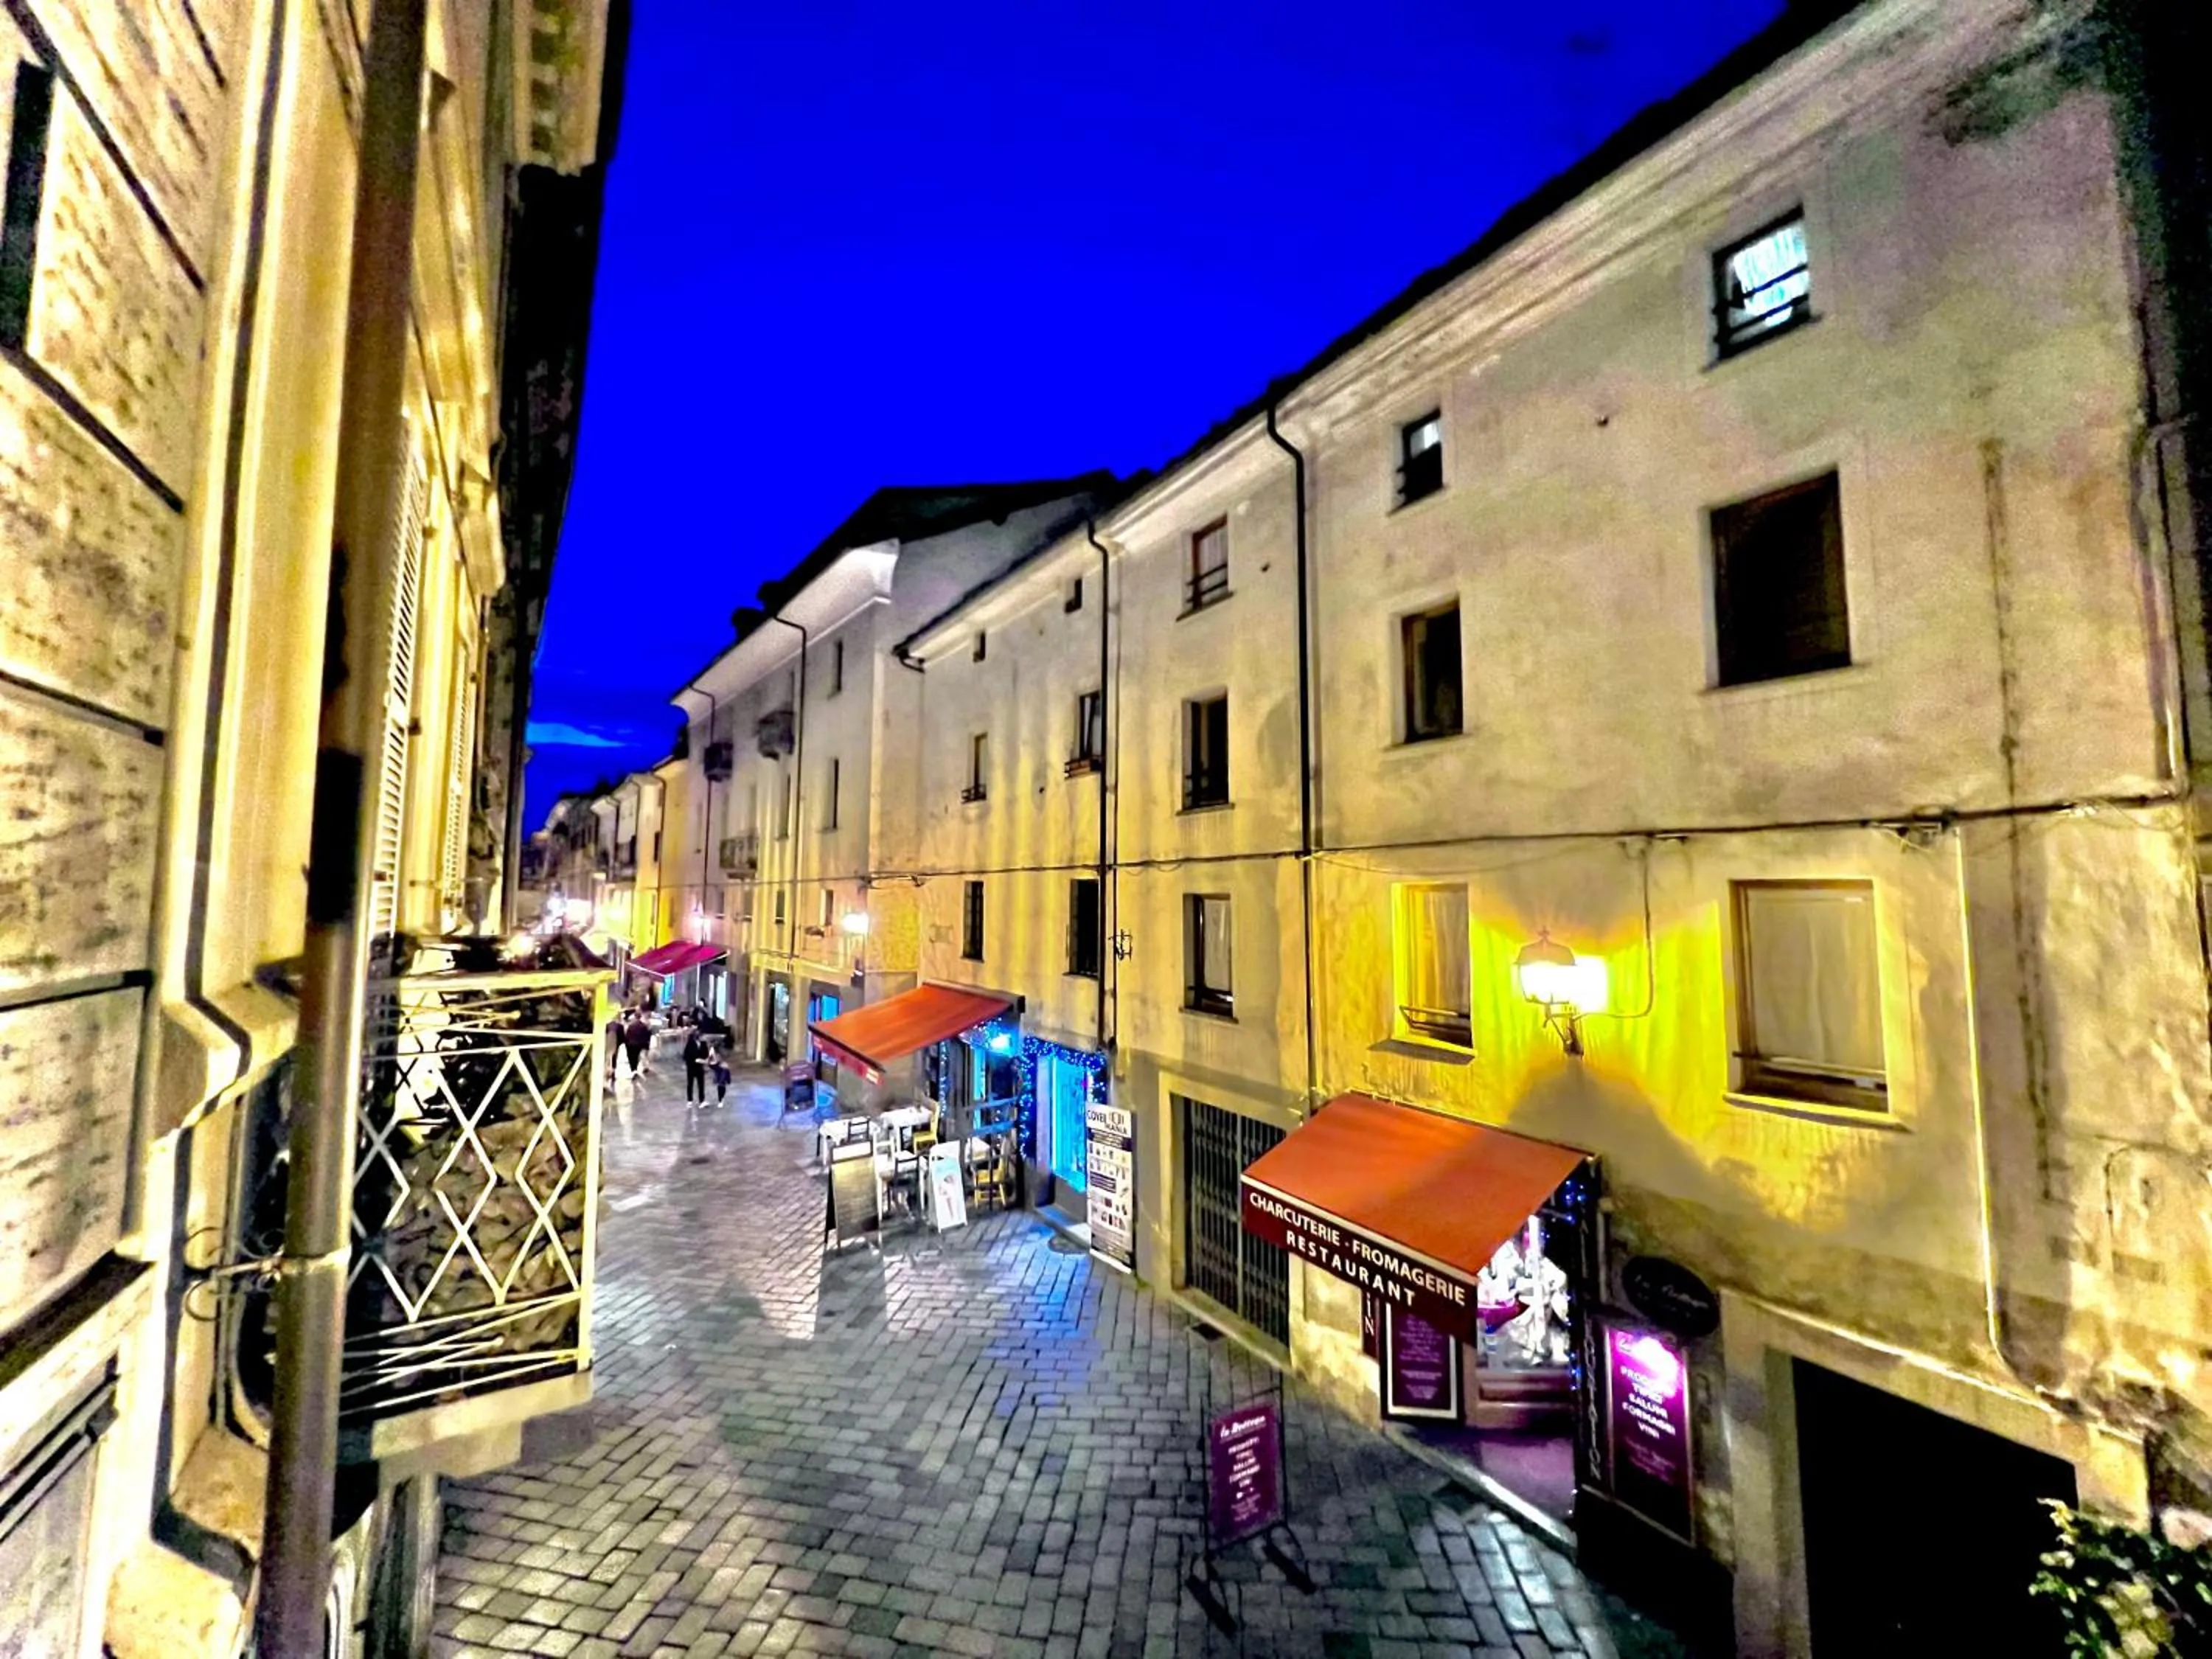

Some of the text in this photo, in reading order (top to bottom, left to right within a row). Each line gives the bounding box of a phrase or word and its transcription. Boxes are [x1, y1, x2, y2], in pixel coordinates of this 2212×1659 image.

[1250, 1192, 1340, 1246] CHARCUTERIE
[1352, 1240, 1466, 1307] FROMAGERIE
[1286, 1230, 1416, 1306] RESTAURANT
